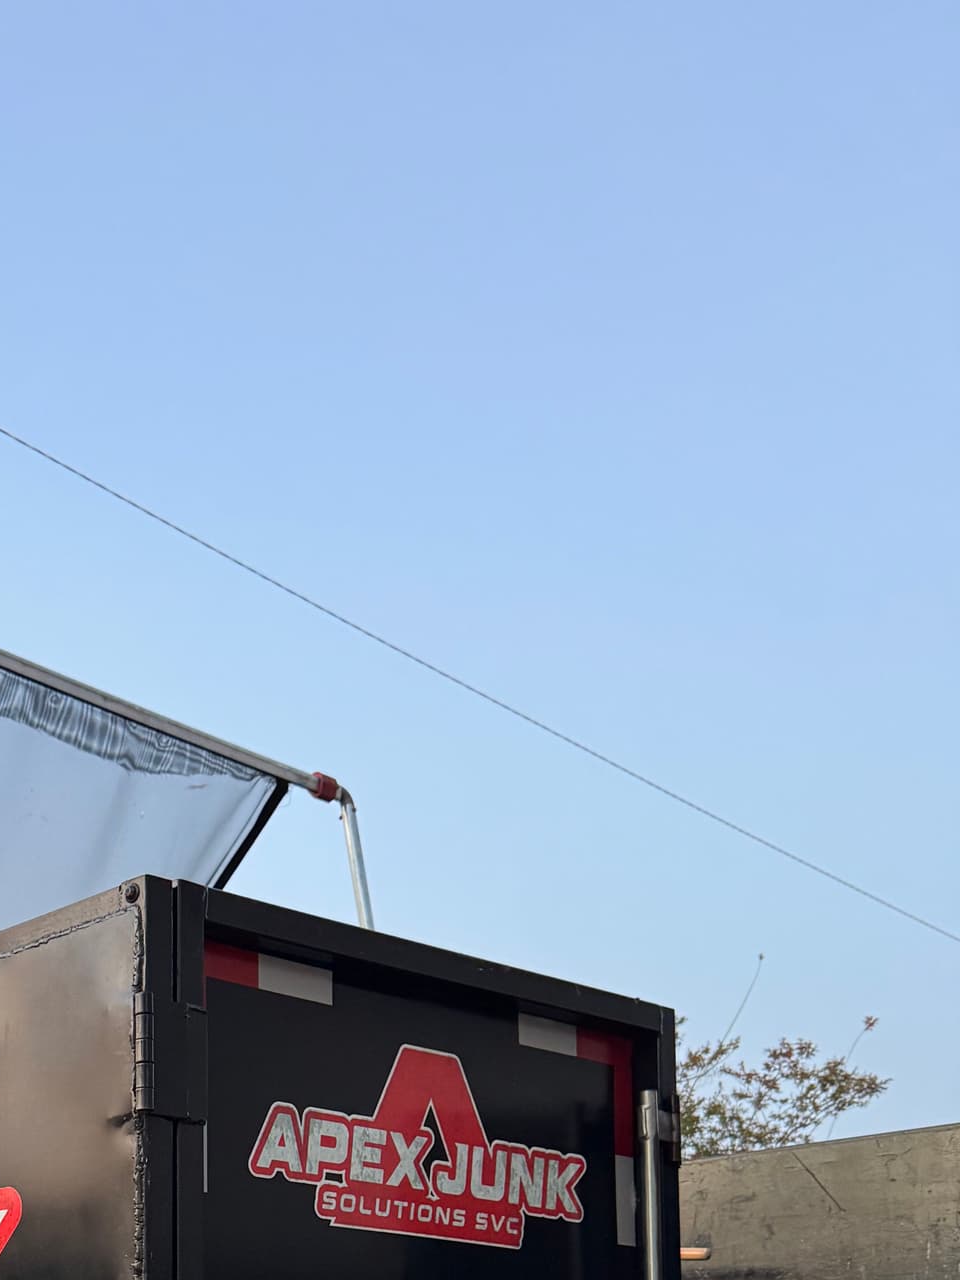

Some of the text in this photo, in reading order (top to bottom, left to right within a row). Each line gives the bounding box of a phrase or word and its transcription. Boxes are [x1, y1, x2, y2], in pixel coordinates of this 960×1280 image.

[256, 1113, 581, 1214] APEX JUNK
[321, 1191, 520, 1236] SOLUTIONS SVC
